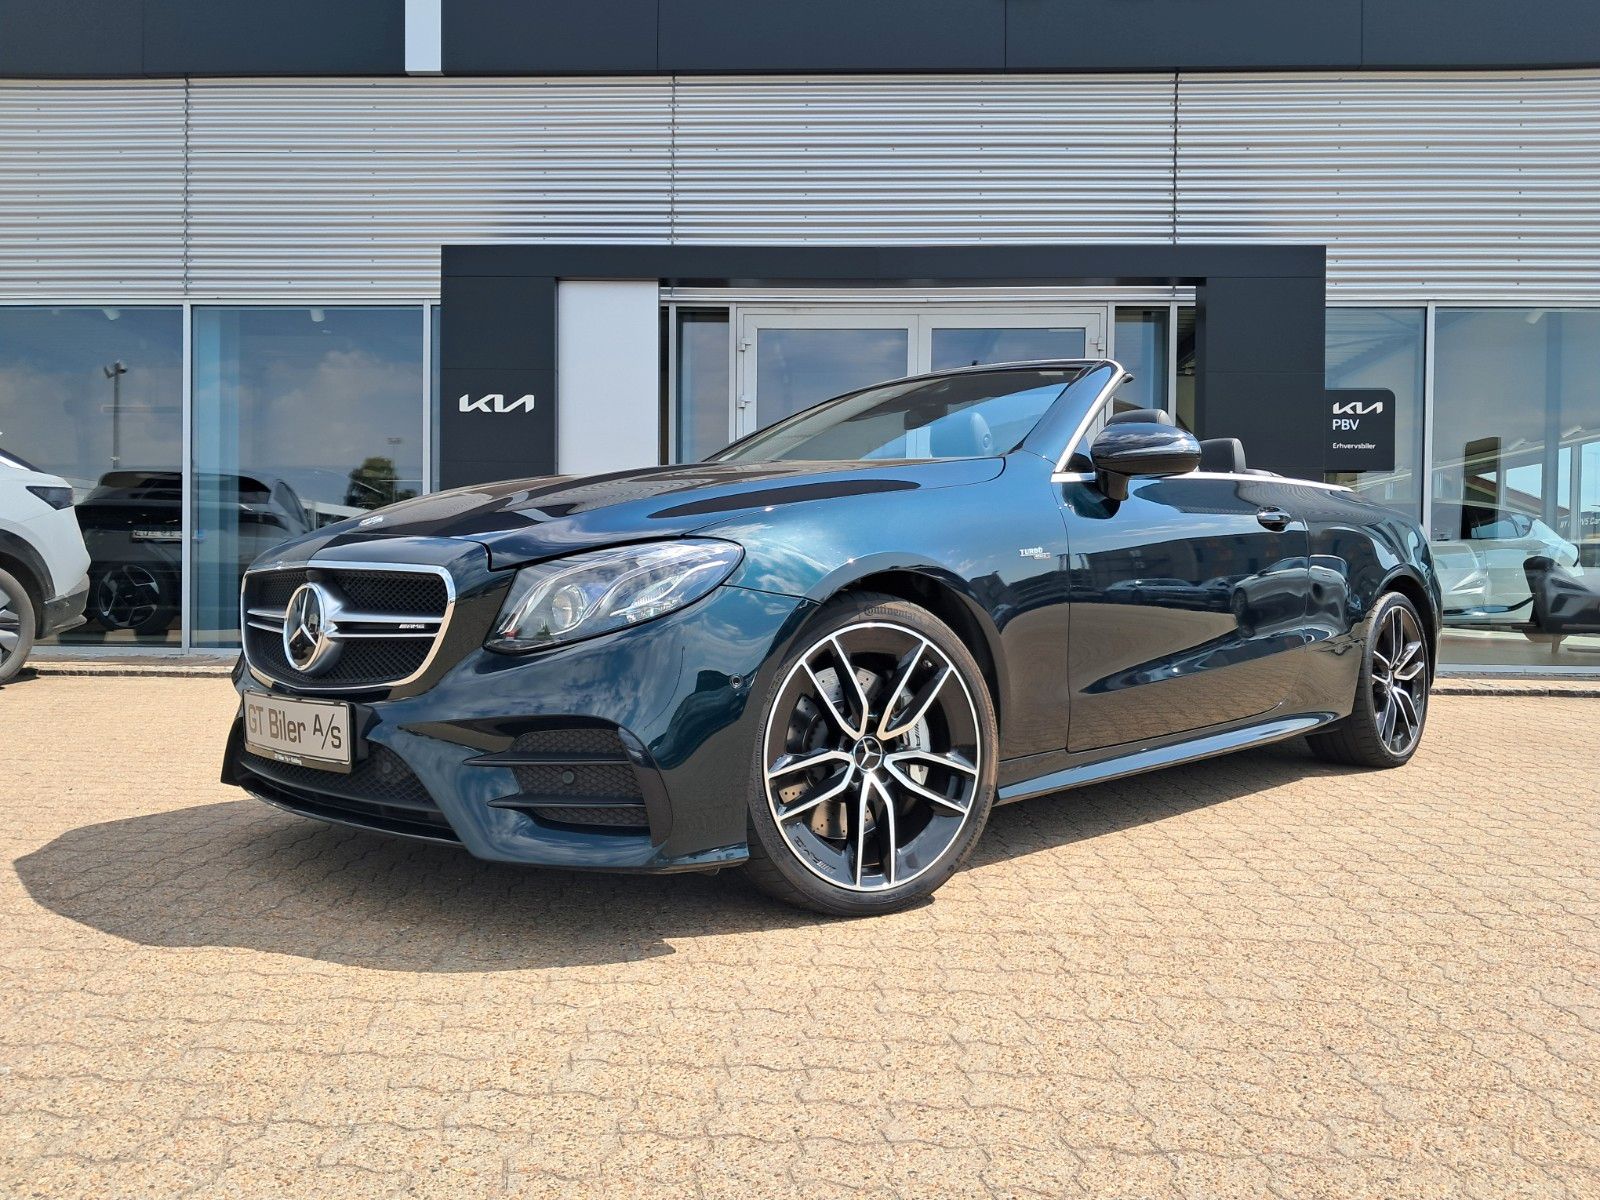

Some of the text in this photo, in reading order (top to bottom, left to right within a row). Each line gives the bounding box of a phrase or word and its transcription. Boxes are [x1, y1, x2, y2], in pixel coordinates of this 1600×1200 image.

[459, 394, 535, 413] KIA
[1332, 401, 1383, 414] KIA
[1332, 418, 1360, 430] PBV
[1019, 547, 1043, 557] TURBO
[248, 703, 264, 736] GT
[268, 707, 307, 744] Biler
